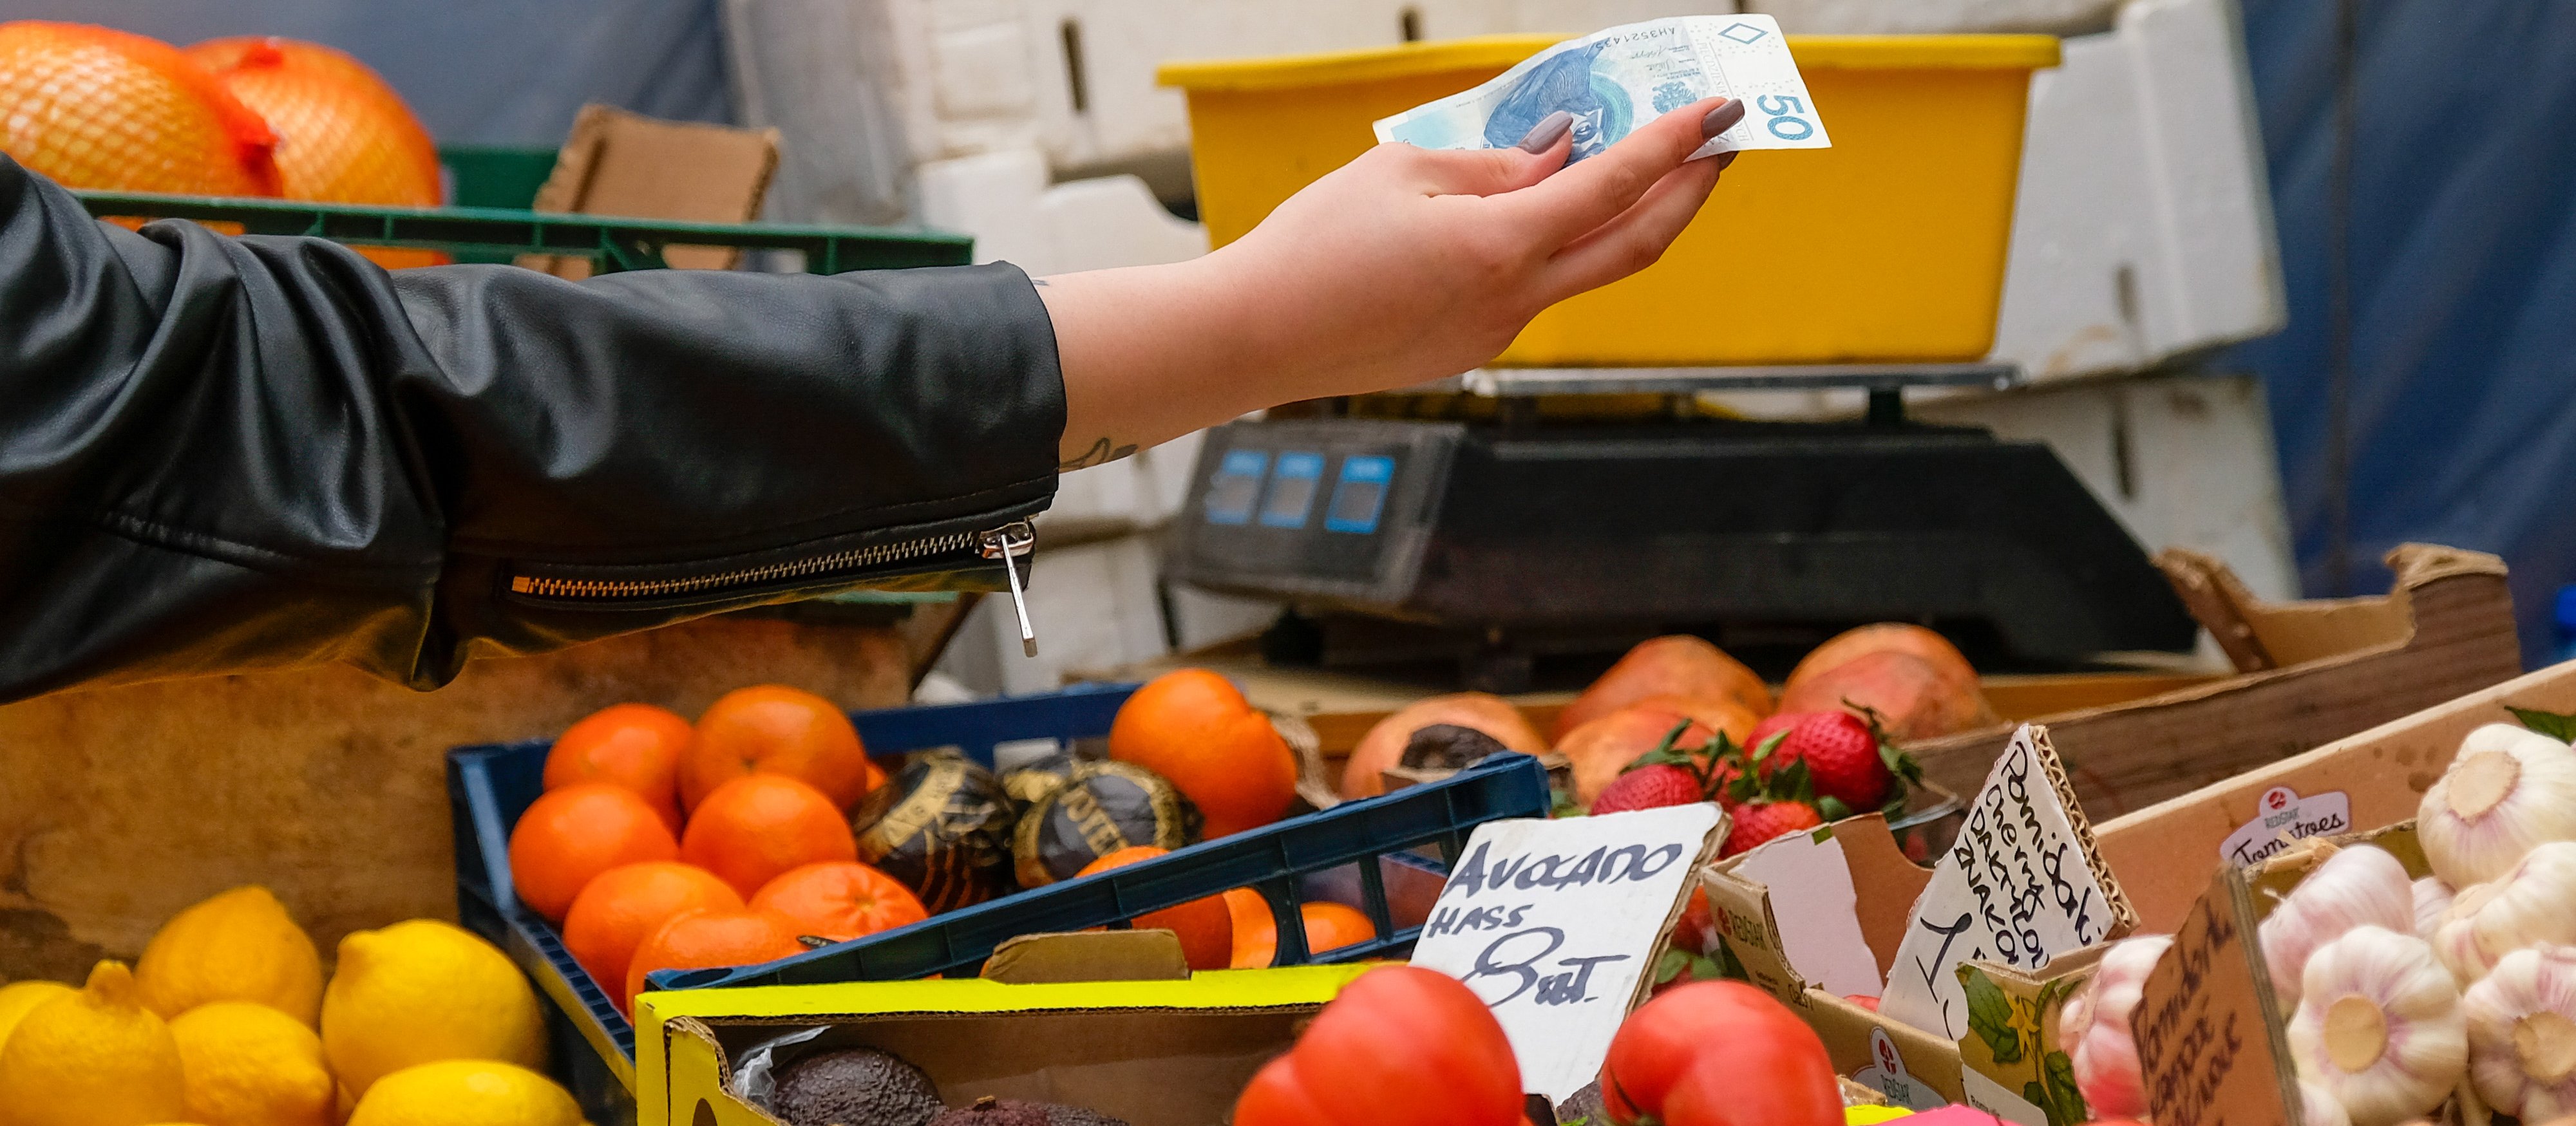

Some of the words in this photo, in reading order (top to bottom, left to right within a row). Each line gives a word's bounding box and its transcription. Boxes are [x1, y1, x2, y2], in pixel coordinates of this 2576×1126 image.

[1757, 94, 1814, 140] 50
[1440, 840, 1683, 899] AVOCADO
[1426, 904, 1534, 938] HASS
[1954, 833, 2020, 964] ZNAKO
